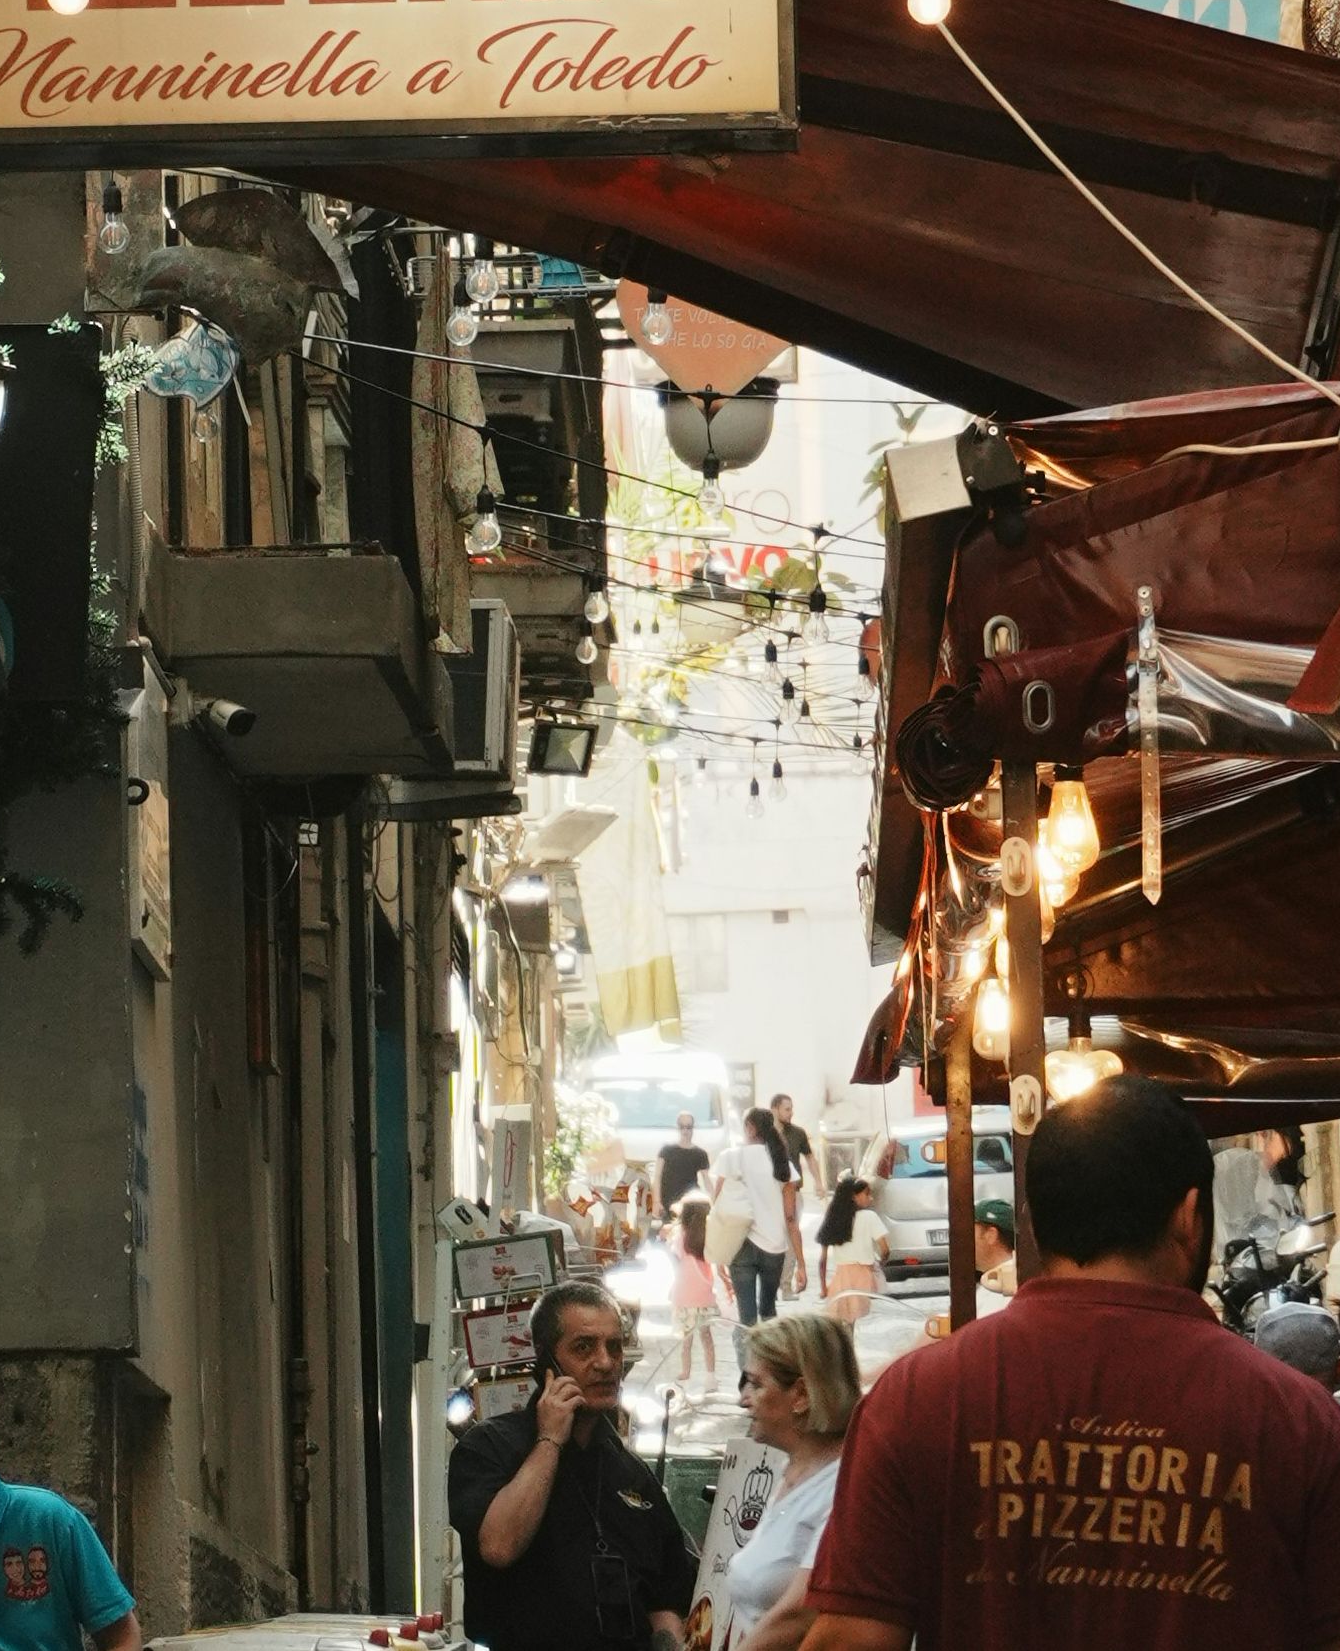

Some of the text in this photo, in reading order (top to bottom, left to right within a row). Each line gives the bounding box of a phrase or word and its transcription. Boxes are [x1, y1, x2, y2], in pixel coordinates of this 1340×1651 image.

[406, 61, 462, 94] a
[477, 18, 722, 110] Toledo
[970, 1439, 1252, 1510] TRATTORIA
[997, 1493, 1225, 1554] PIZZERIA
